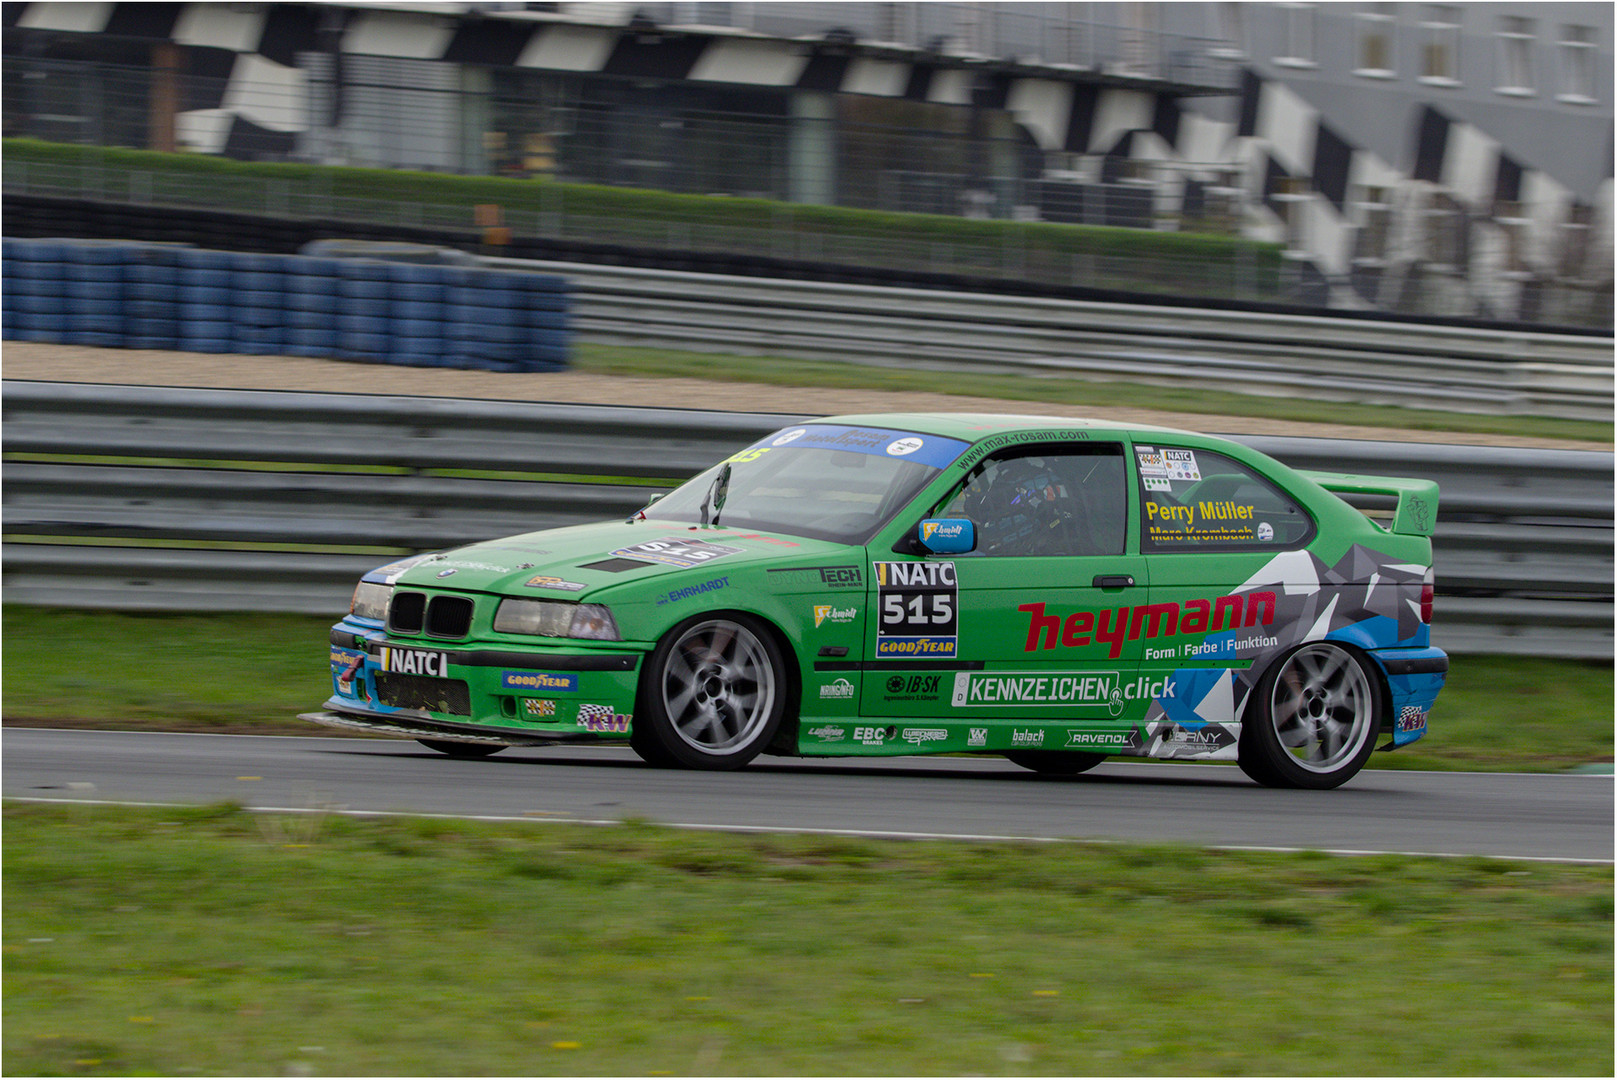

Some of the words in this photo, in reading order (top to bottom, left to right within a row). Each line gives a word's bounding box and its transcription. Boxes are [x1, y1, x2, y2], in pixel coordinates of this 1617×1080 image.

[957, 430, 1090, 470] www.max-rosam.com
[1167, 451, 1190, 460] NATC
[1146, 502, 1194, 525] Perry
[1199, 501, 1254, 520] Müller
[891, 563, 955, 587] NATC
[668, 576, 730, 603] EHRHARDT
[883, 594, 953, 625] 515
[1018, 591, 1277, 659] heymann
[879, 638, 955, 656] GOODYEAR
[1145, 647, 1176, 660] Form
[1184, 640, 1218, 655] Farbe
[1226, 635, 1278, 651] Funktion
[390, 647, 438, 677] NATC
[507, 674, 570, 688] GOODYEAR
[970, 677, 1110, 701] KENNZEICHEN
[1124, 676, 1177, 699] click
[853, 727, 885, 740] EBC
[1072, 734, 1129, 744] RAVENOL
